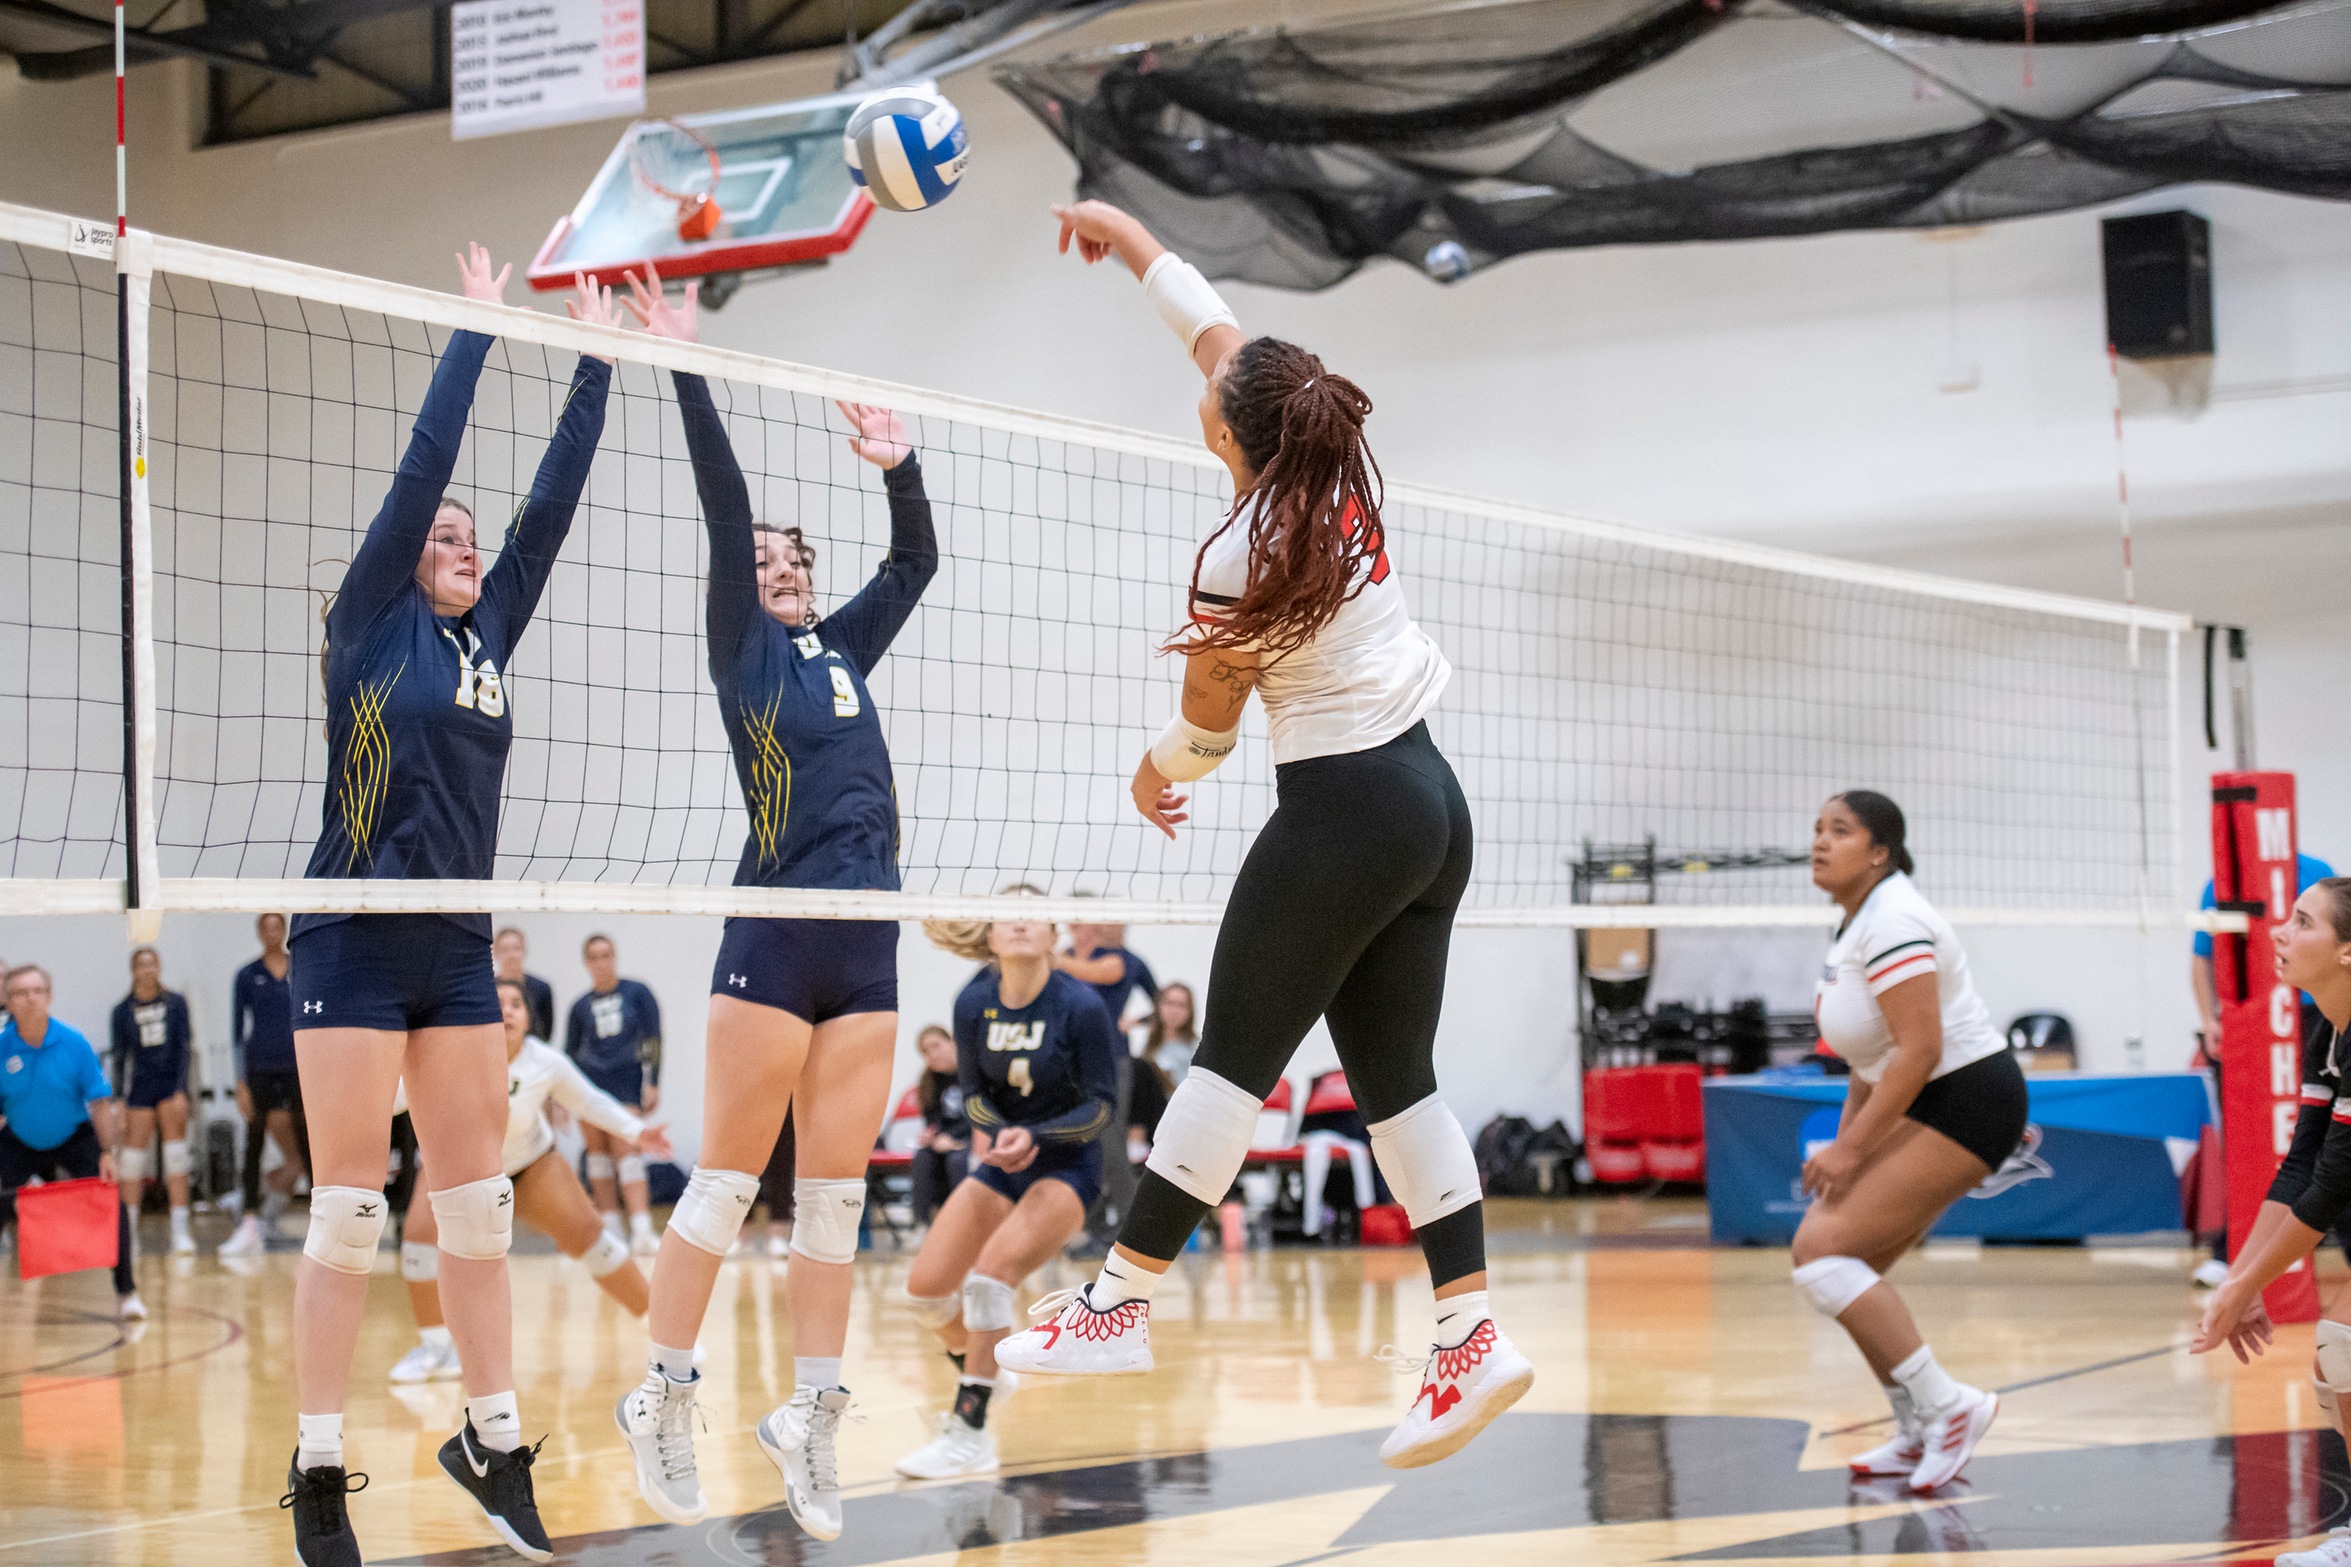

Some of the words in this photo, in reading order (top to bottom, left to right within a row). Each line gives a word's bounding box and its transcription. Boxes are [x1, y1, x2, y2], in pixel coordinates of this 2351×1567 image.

[90, 227, 114, 238] jaypro
[90, 236, 113, 247] sports
[828, 665, 861, 718] 9
[986, 1020, 1047, 1052] USJ
[1007, 1056, 1034, 1098] 4
